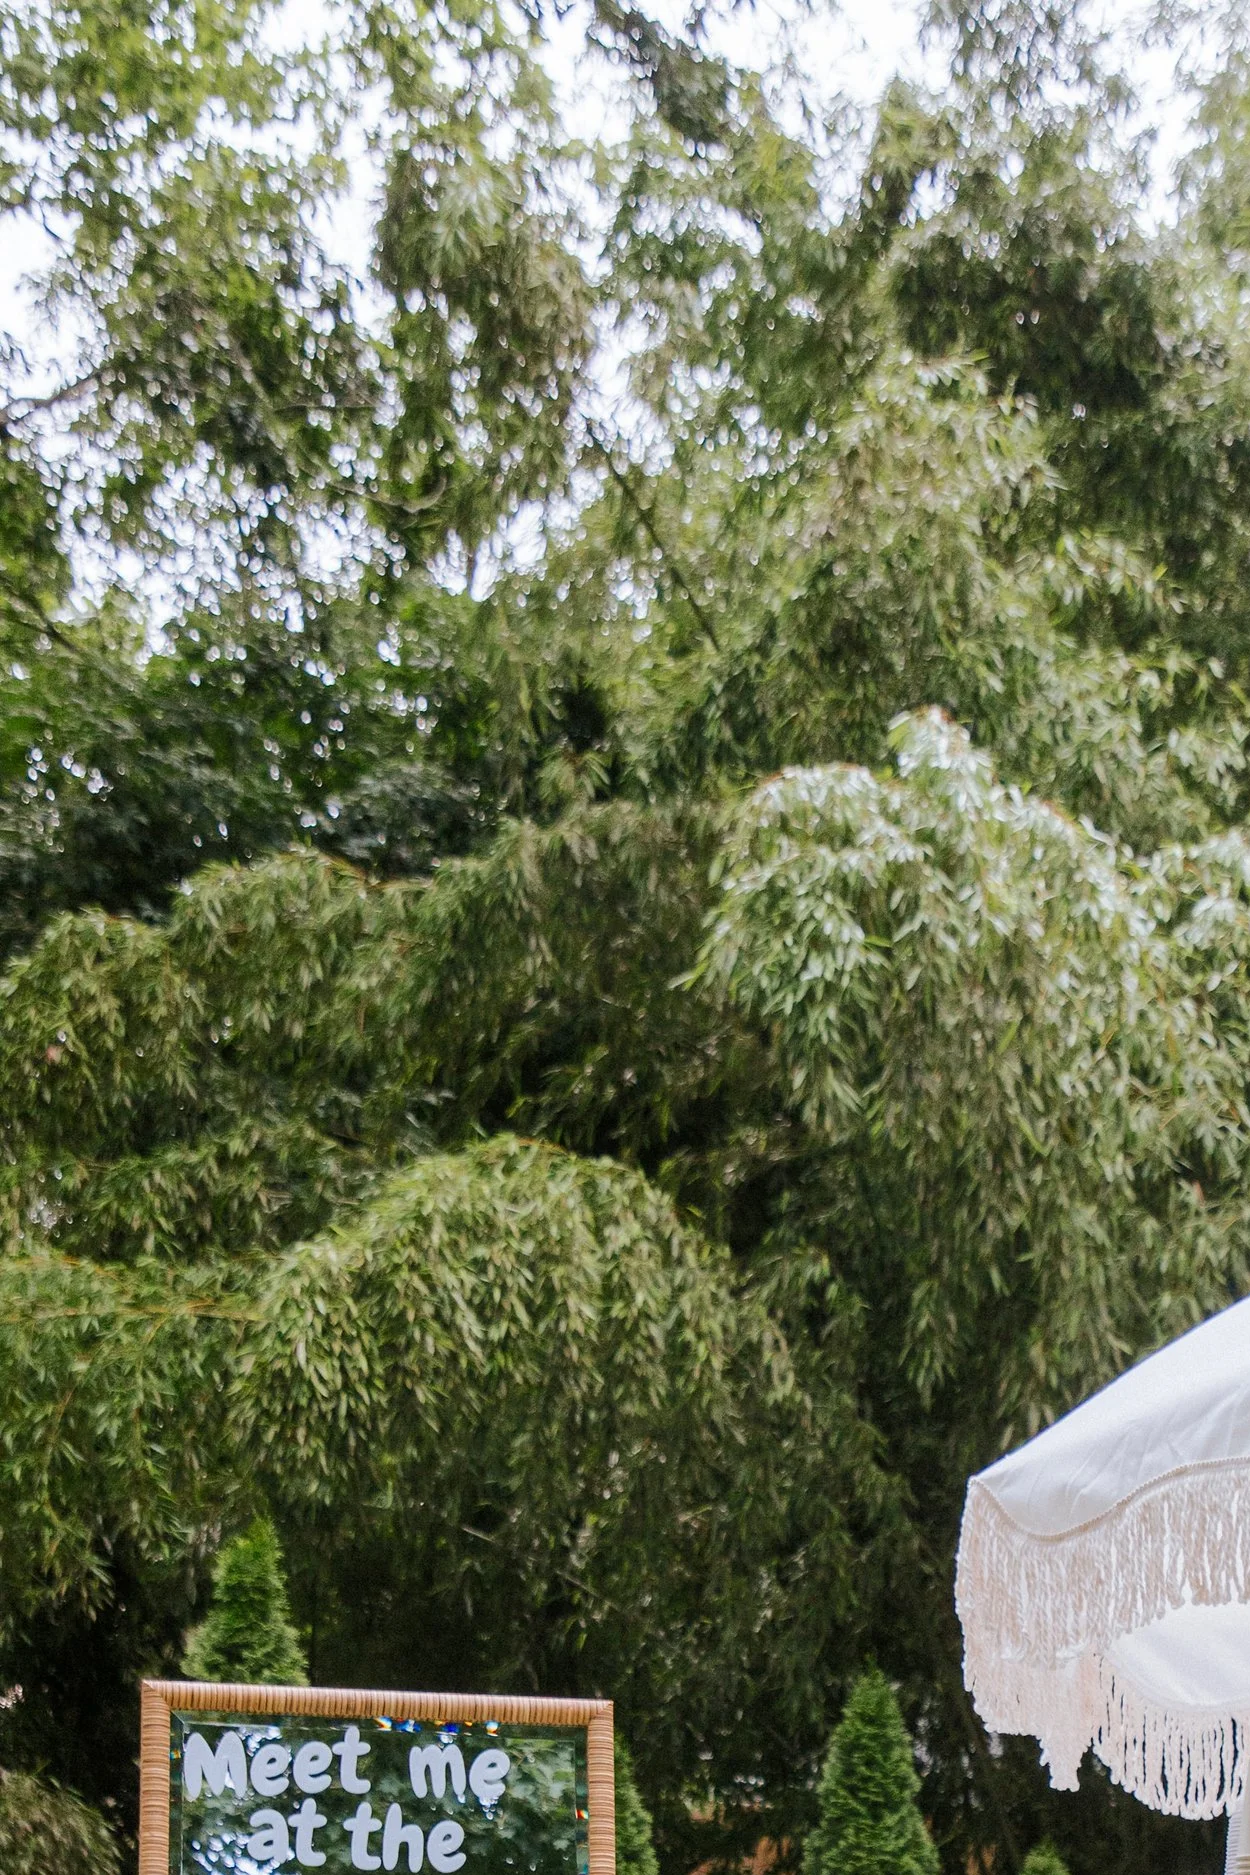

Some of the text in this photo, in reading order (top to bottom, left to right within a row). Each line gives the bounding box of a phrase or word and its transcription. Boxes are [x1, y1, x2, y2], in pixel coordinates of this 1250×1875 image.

[183, 1725, 511, 1801] Meet me
[246, 1798, 467, 1874] at the
